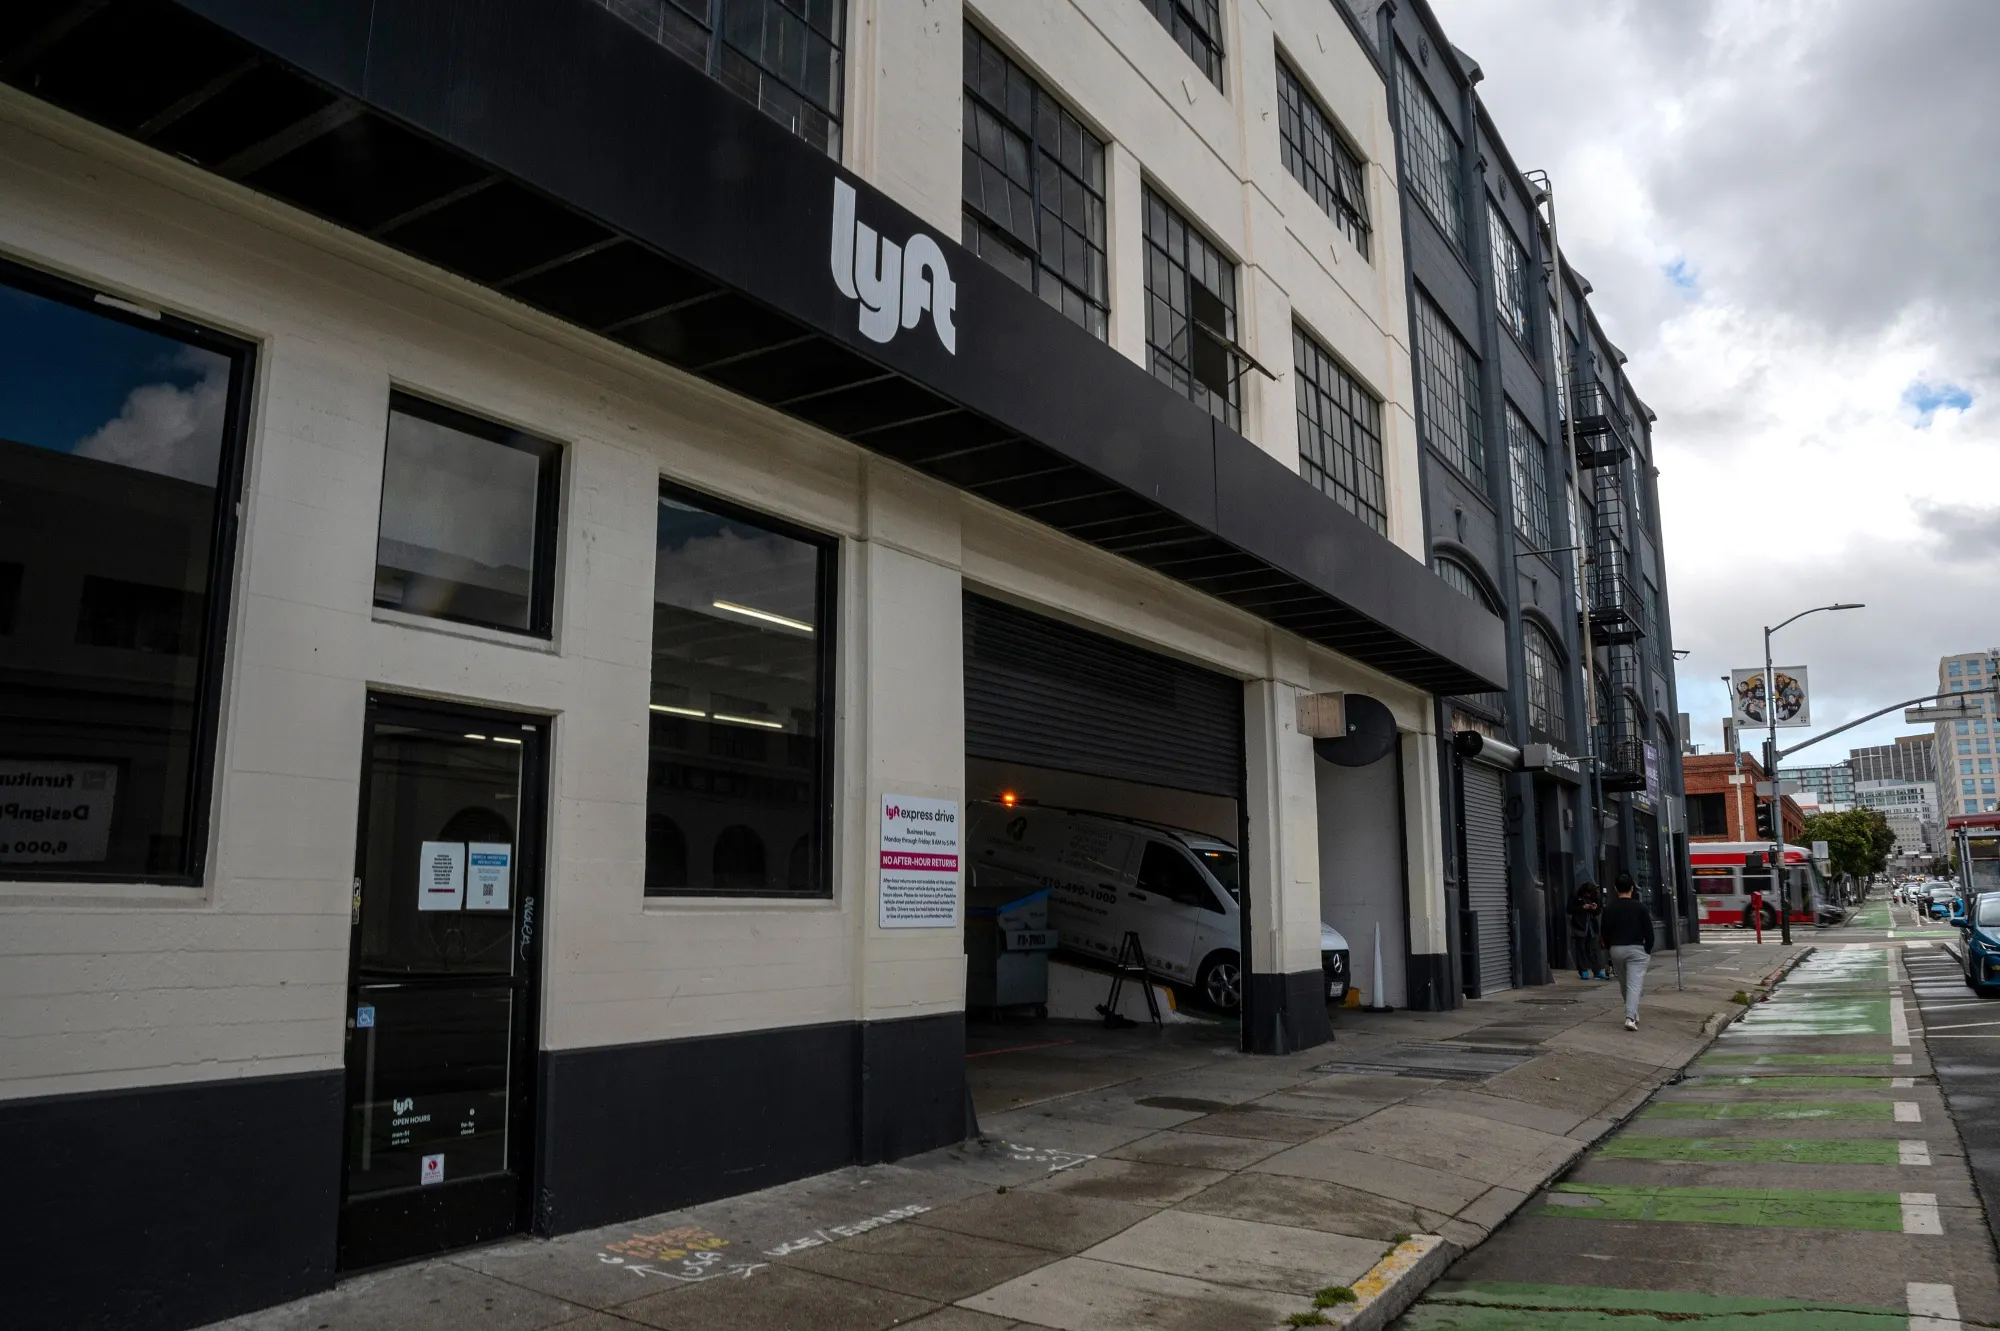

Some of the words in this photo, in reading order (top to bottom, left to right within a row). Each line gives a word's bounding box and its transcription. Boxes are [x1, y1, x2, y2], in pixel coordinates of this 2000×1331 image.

[831, 176, 956, 356] lyft
[886, 805, 900, 820] lyft
[901, 809, 933, 822] express
[935, 810, 954, 823] drive
[883, 856, 892, 864] NO
[893, 856, 931, 866] AFTER-HOUR
[932, 859, 956, 867] RETURNS
[393, 1097, 414, 1116] lyft
[392, 1117, 410, 1126] OPEN
[410, 1114, 431, 1124] HOURS
